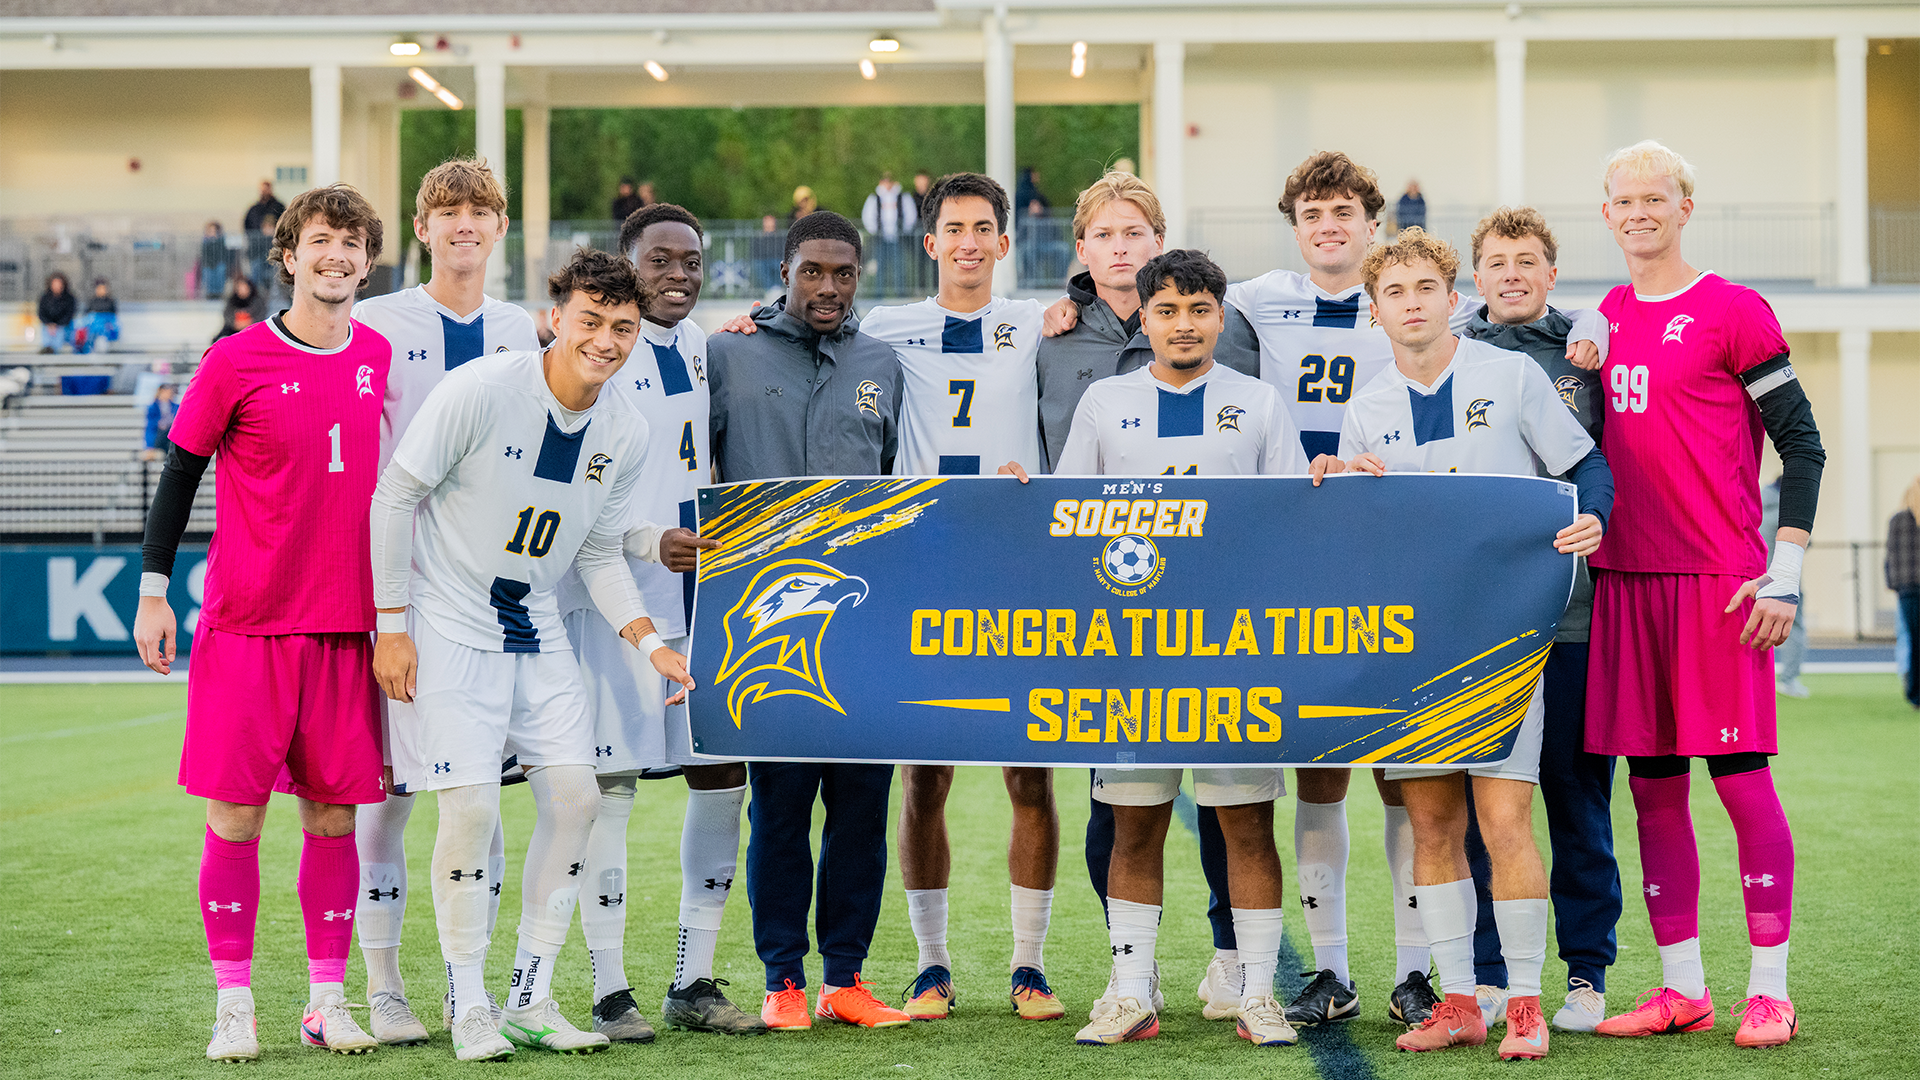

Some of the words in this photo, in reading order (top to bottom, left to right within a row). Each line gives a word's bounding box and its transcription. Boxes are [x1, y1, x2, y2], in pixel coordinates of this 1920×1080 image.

[1297, 353, 1356, 404] 29
[1611, 364, 1649, 413] 99
[948, 379, 976, 428] 7
[328, 423, 344, 472] 1
[678, 420, 698, 472] 4
[1102, 483, 1163, 494] MEN'S
[504, 505, 562, 558] 10
[1050, 499, 1208, 537] SOCCER
[1094, 568, 1112, 590] MARY'S
[1110, 586, 1138, 597] COLLEGE
[1138, 586, 1147, 595] OF
[1147, 557, 1167, 589] MARYLAND
[911, 605, 1414, 657] CONGRATULATIONS
[1027, 687, 1282, 743] SENIORS
